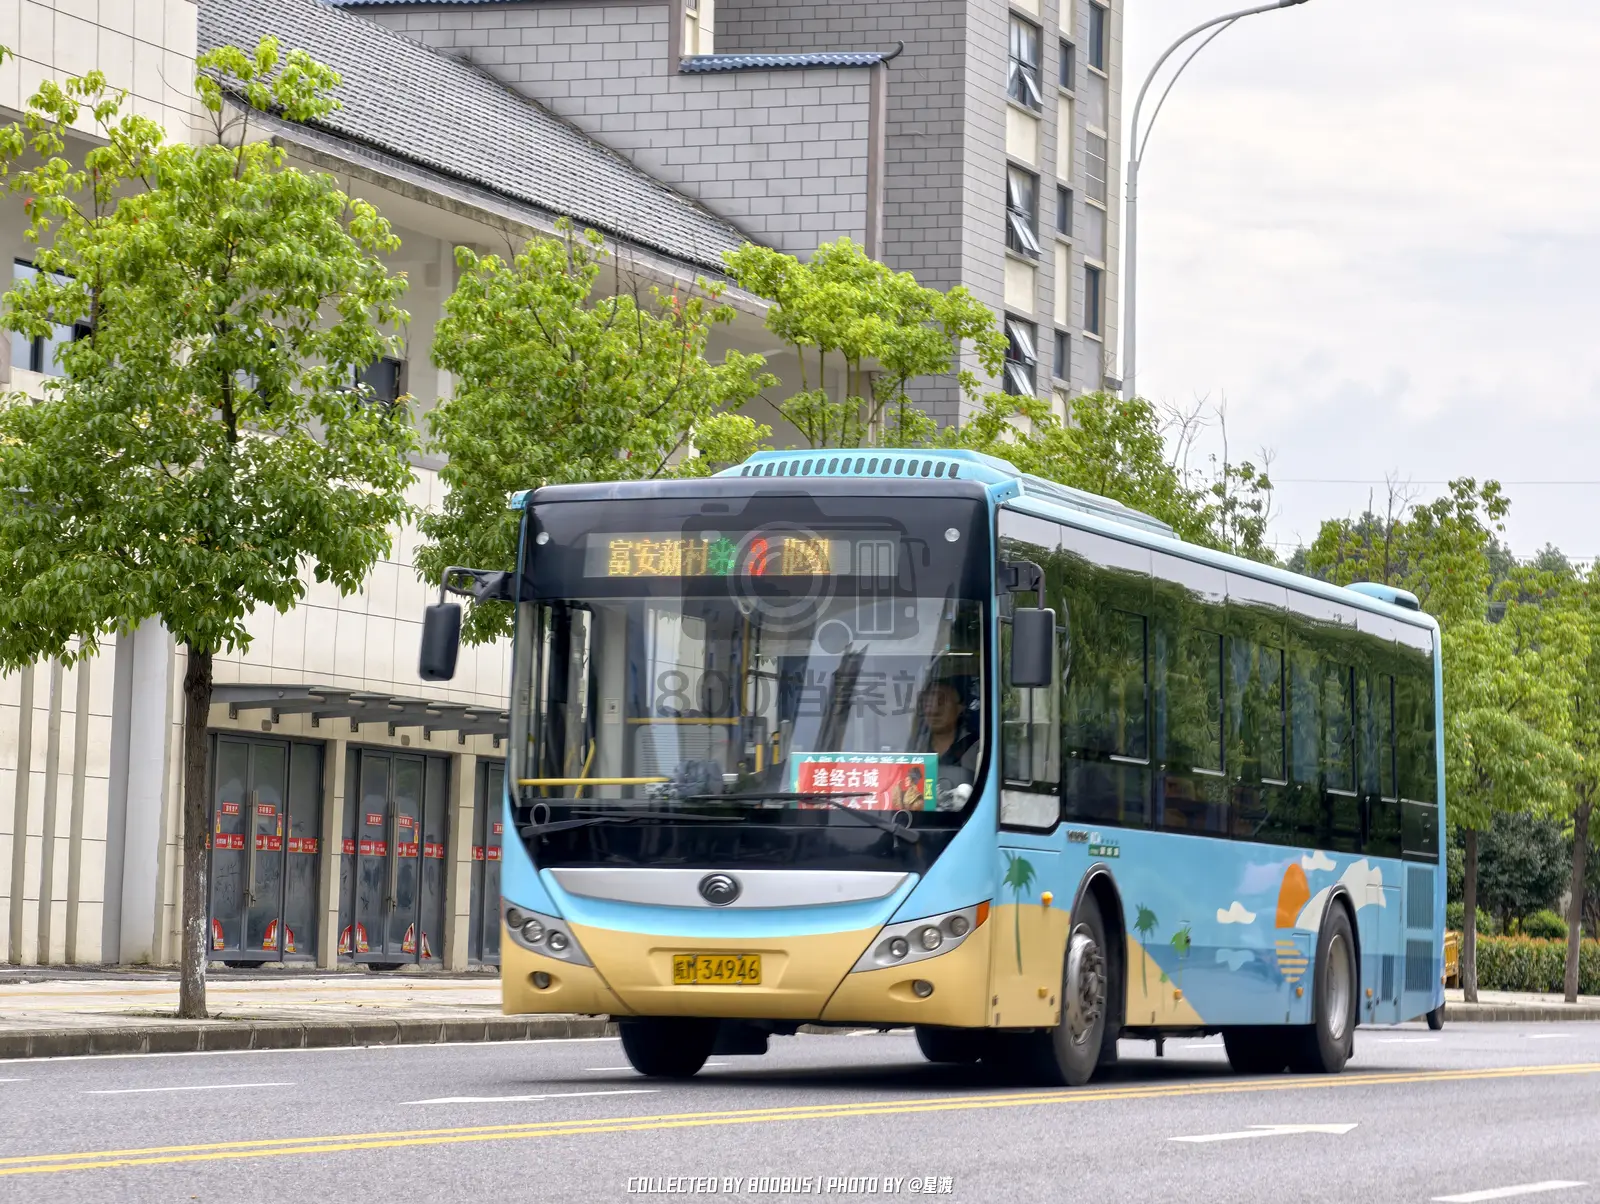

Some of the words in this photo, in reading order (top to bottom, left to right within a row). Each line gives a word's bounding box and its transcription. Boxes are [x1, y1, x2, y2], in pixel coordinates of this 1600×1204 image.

[608, 539, 708, 576] 富安新村
[812, 767, 880, 788] 途经古城
